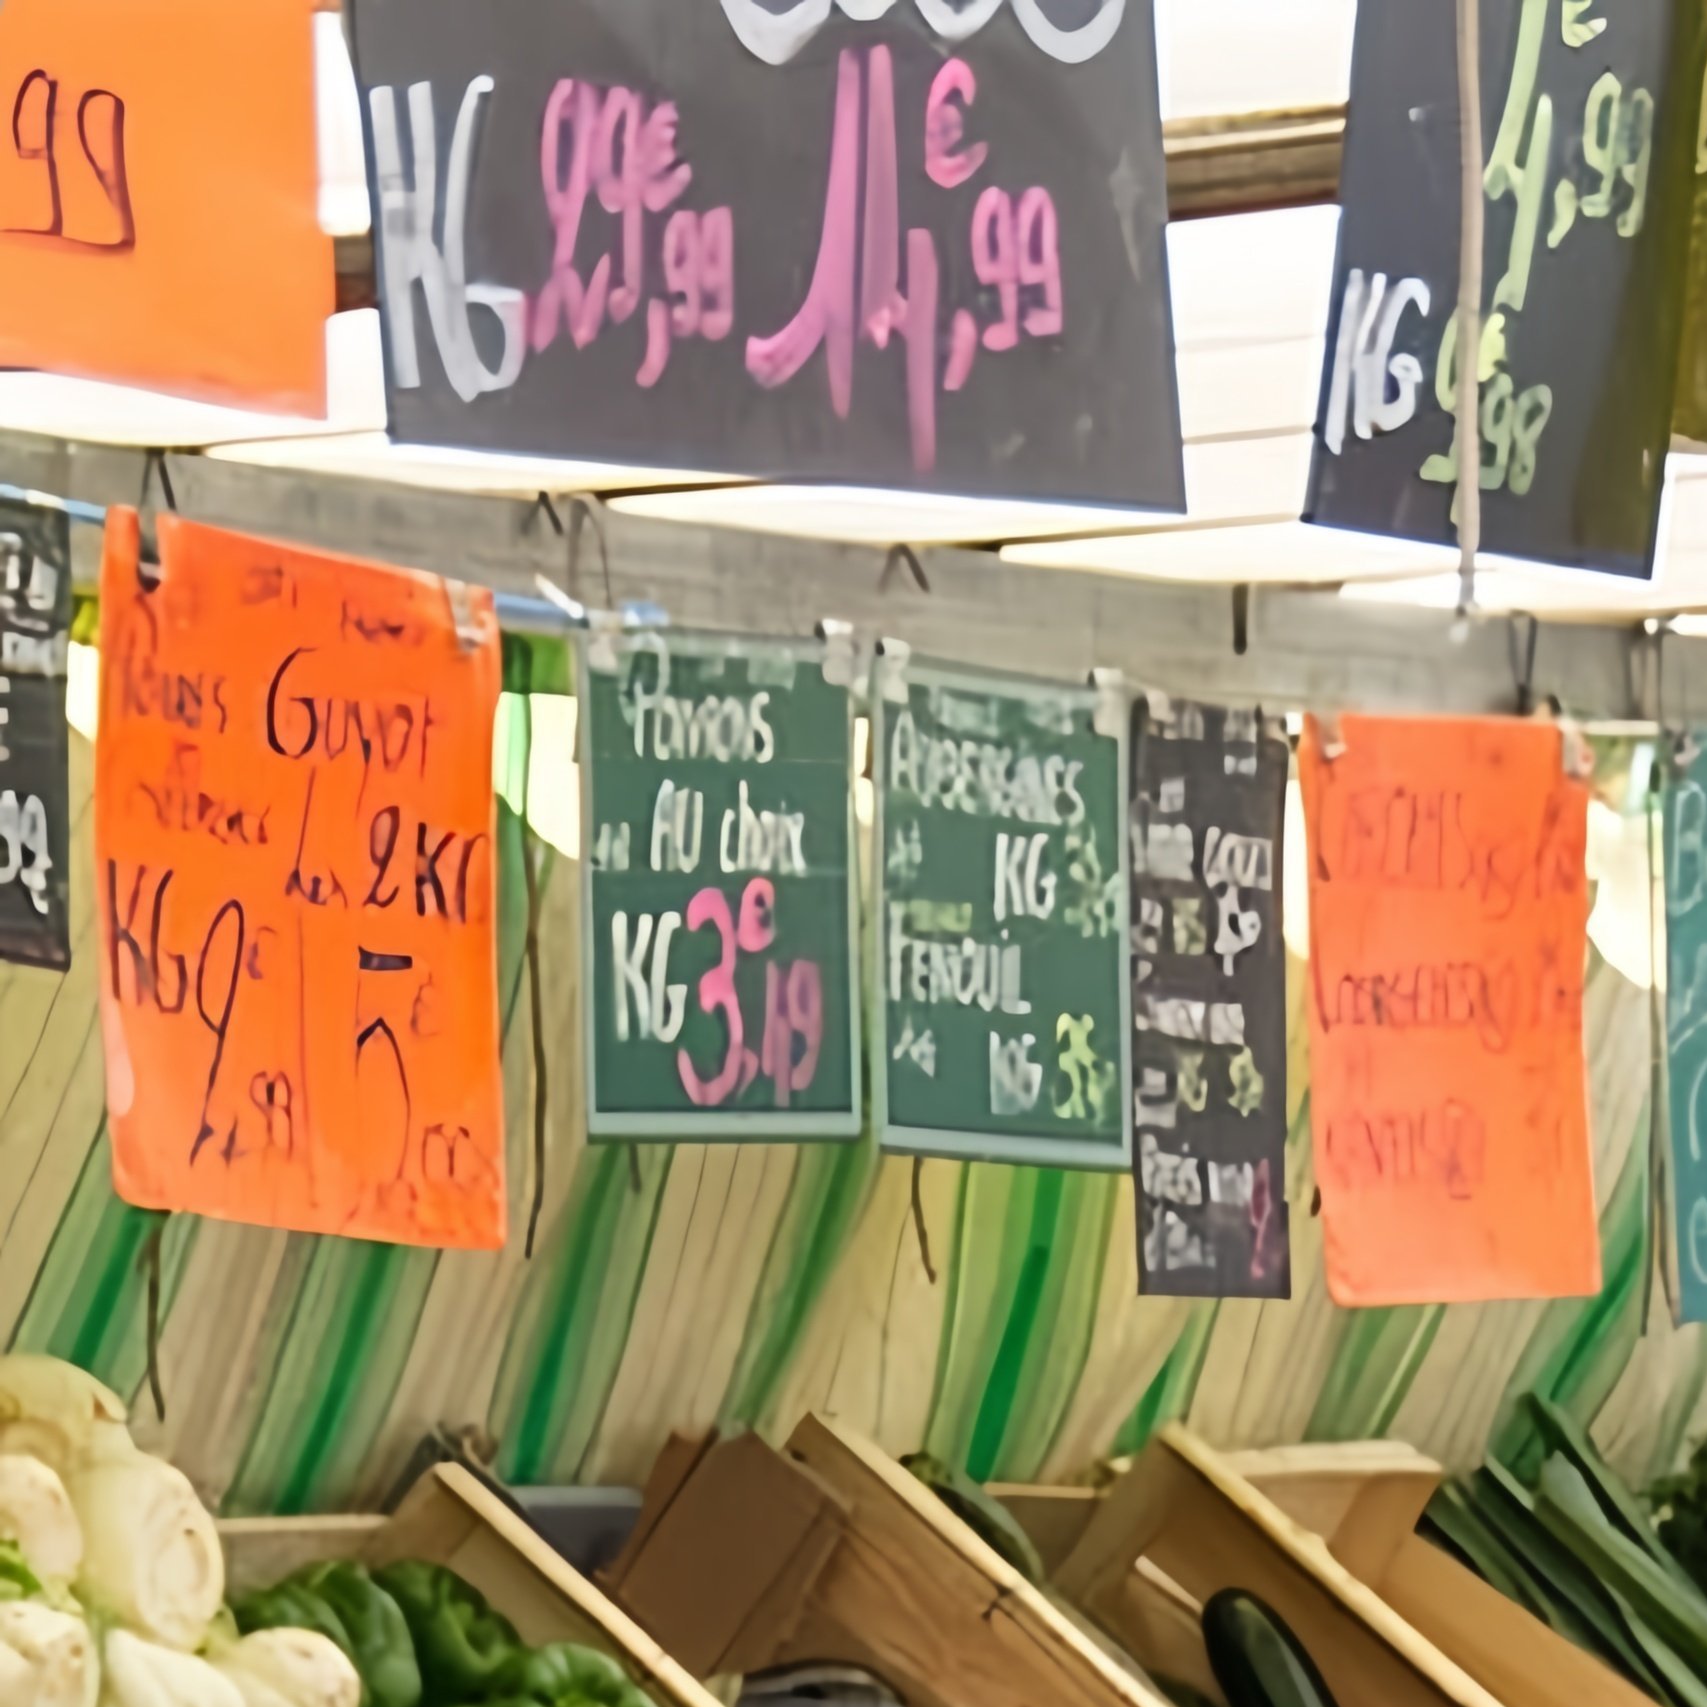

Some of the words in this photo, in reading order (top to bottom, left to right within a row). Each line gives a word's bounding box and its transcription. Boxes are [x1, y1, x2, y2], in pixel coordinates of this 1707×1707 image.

[367, 74, 524, 403] KG
[1324, 267, 1432, 456] KG
[994, 832, 1057, 921] KG
[611, 908, 688, 1043] KG
